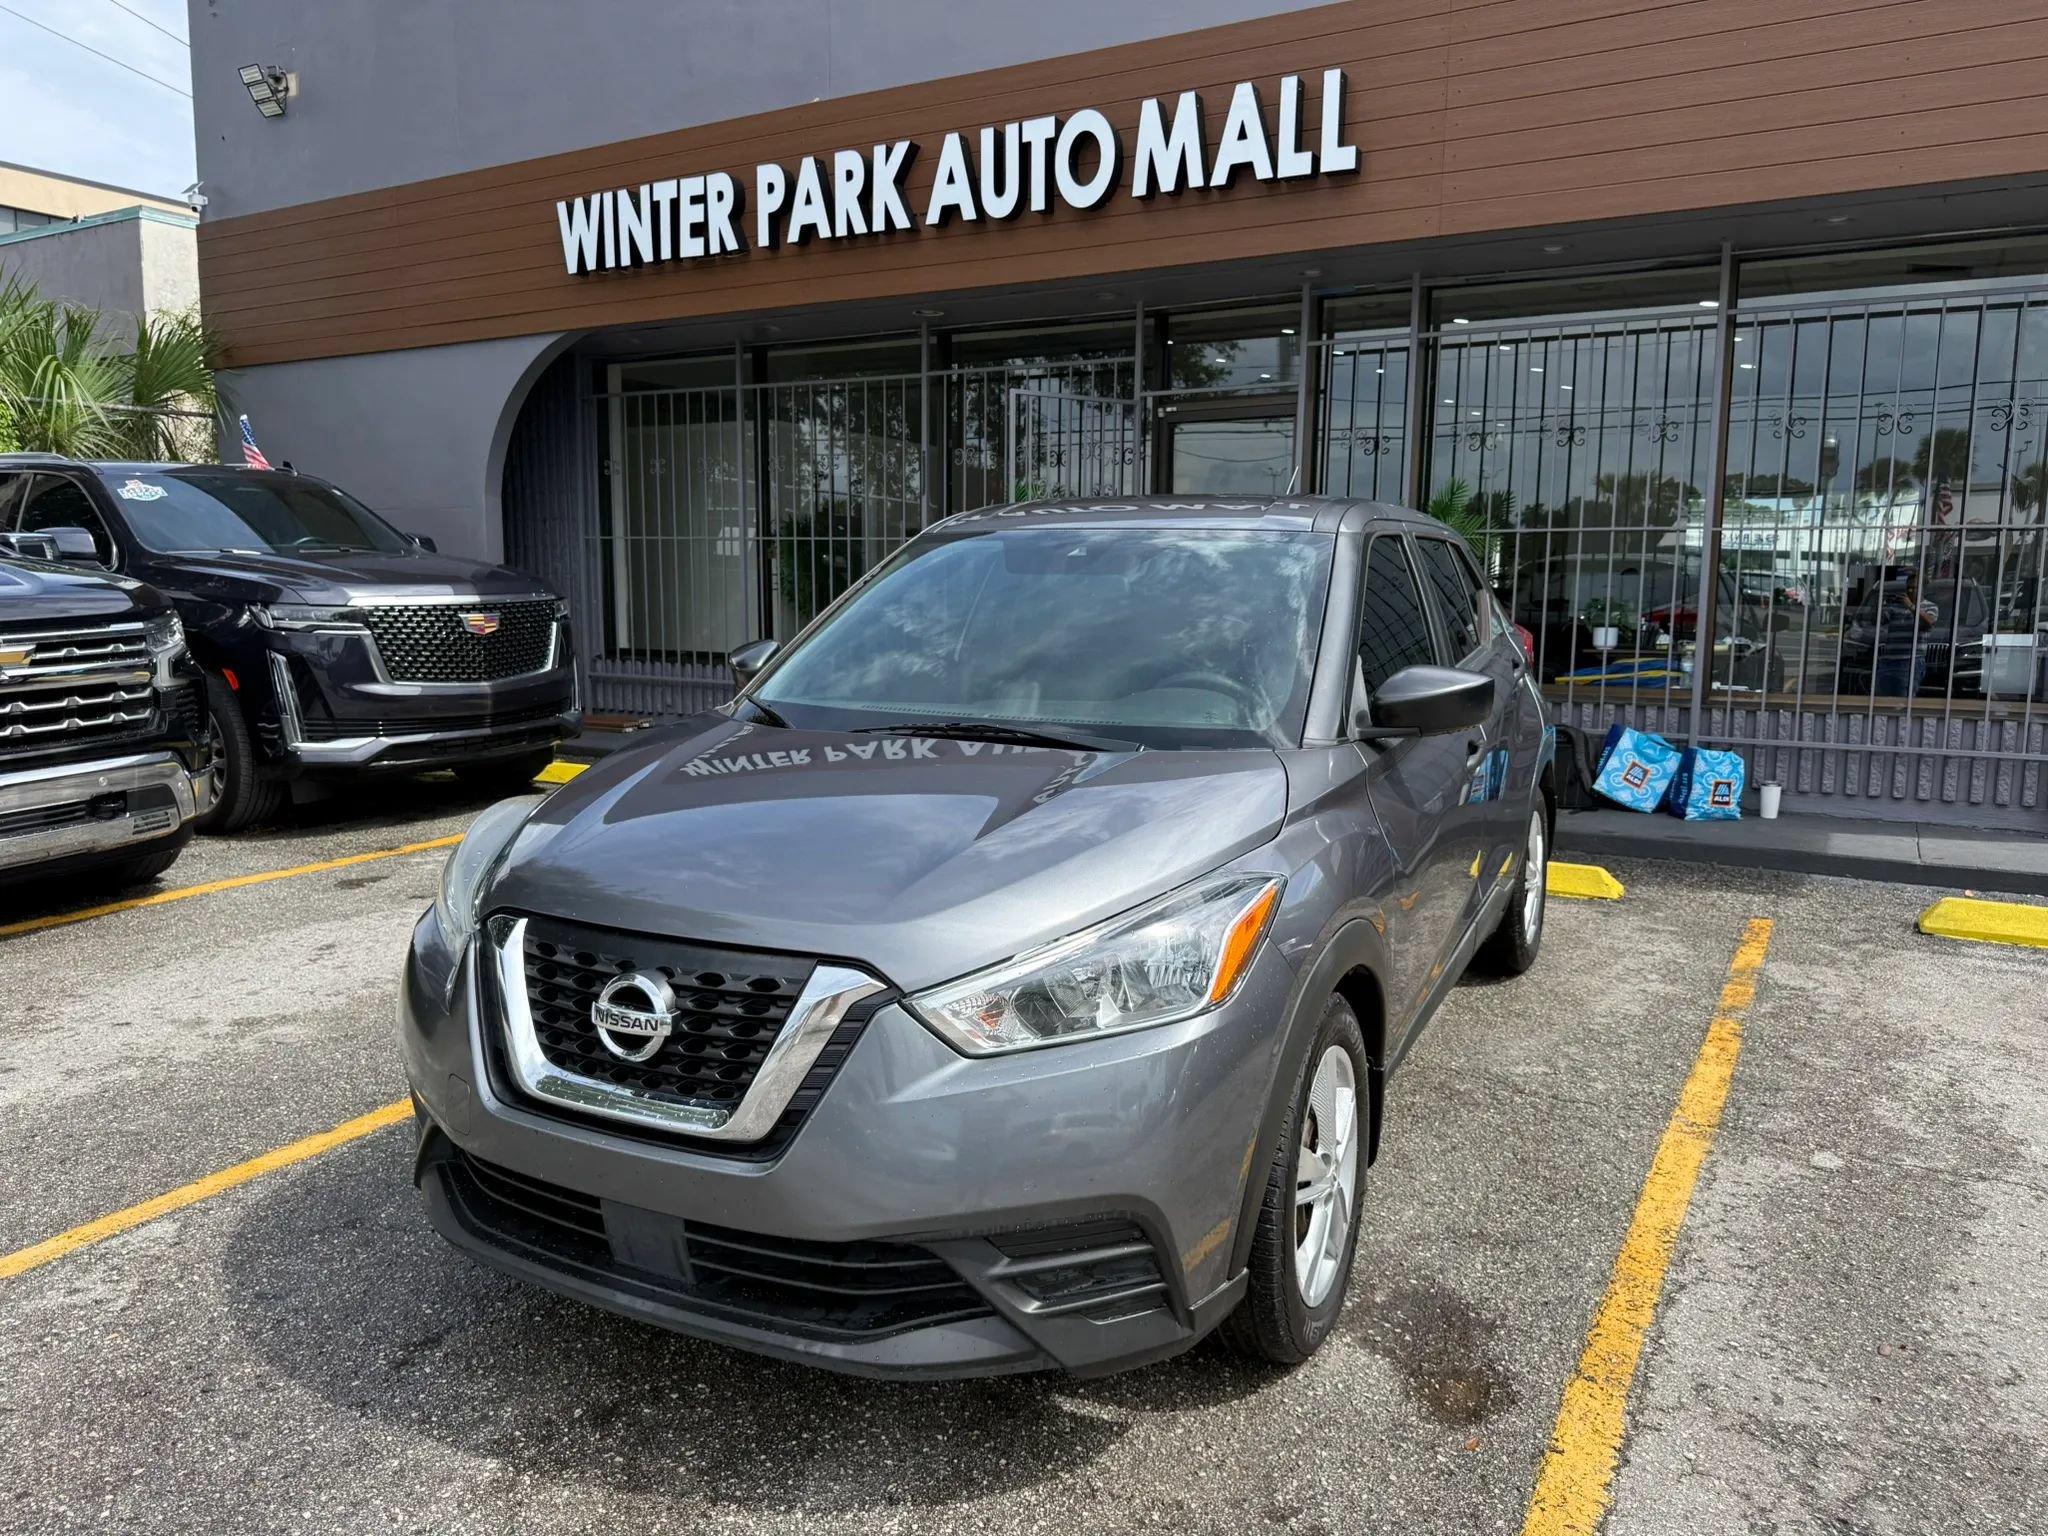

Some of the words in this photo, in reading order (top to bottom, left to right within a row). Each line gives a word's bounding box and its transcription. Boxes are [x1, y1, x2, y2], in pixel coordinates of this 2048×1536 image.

[556, 172, 739, 275] WINTER
[756, 140, 911, 248] PARK
[925, 109, 1116, 227] AUTO
[1132, 69, 1357, 197] MALL
[1625, 773, 1643, 786] ALDI
[1713, 795, 1730, 803] ALDI
[594, 1005, 659, 1032] NISSAN
